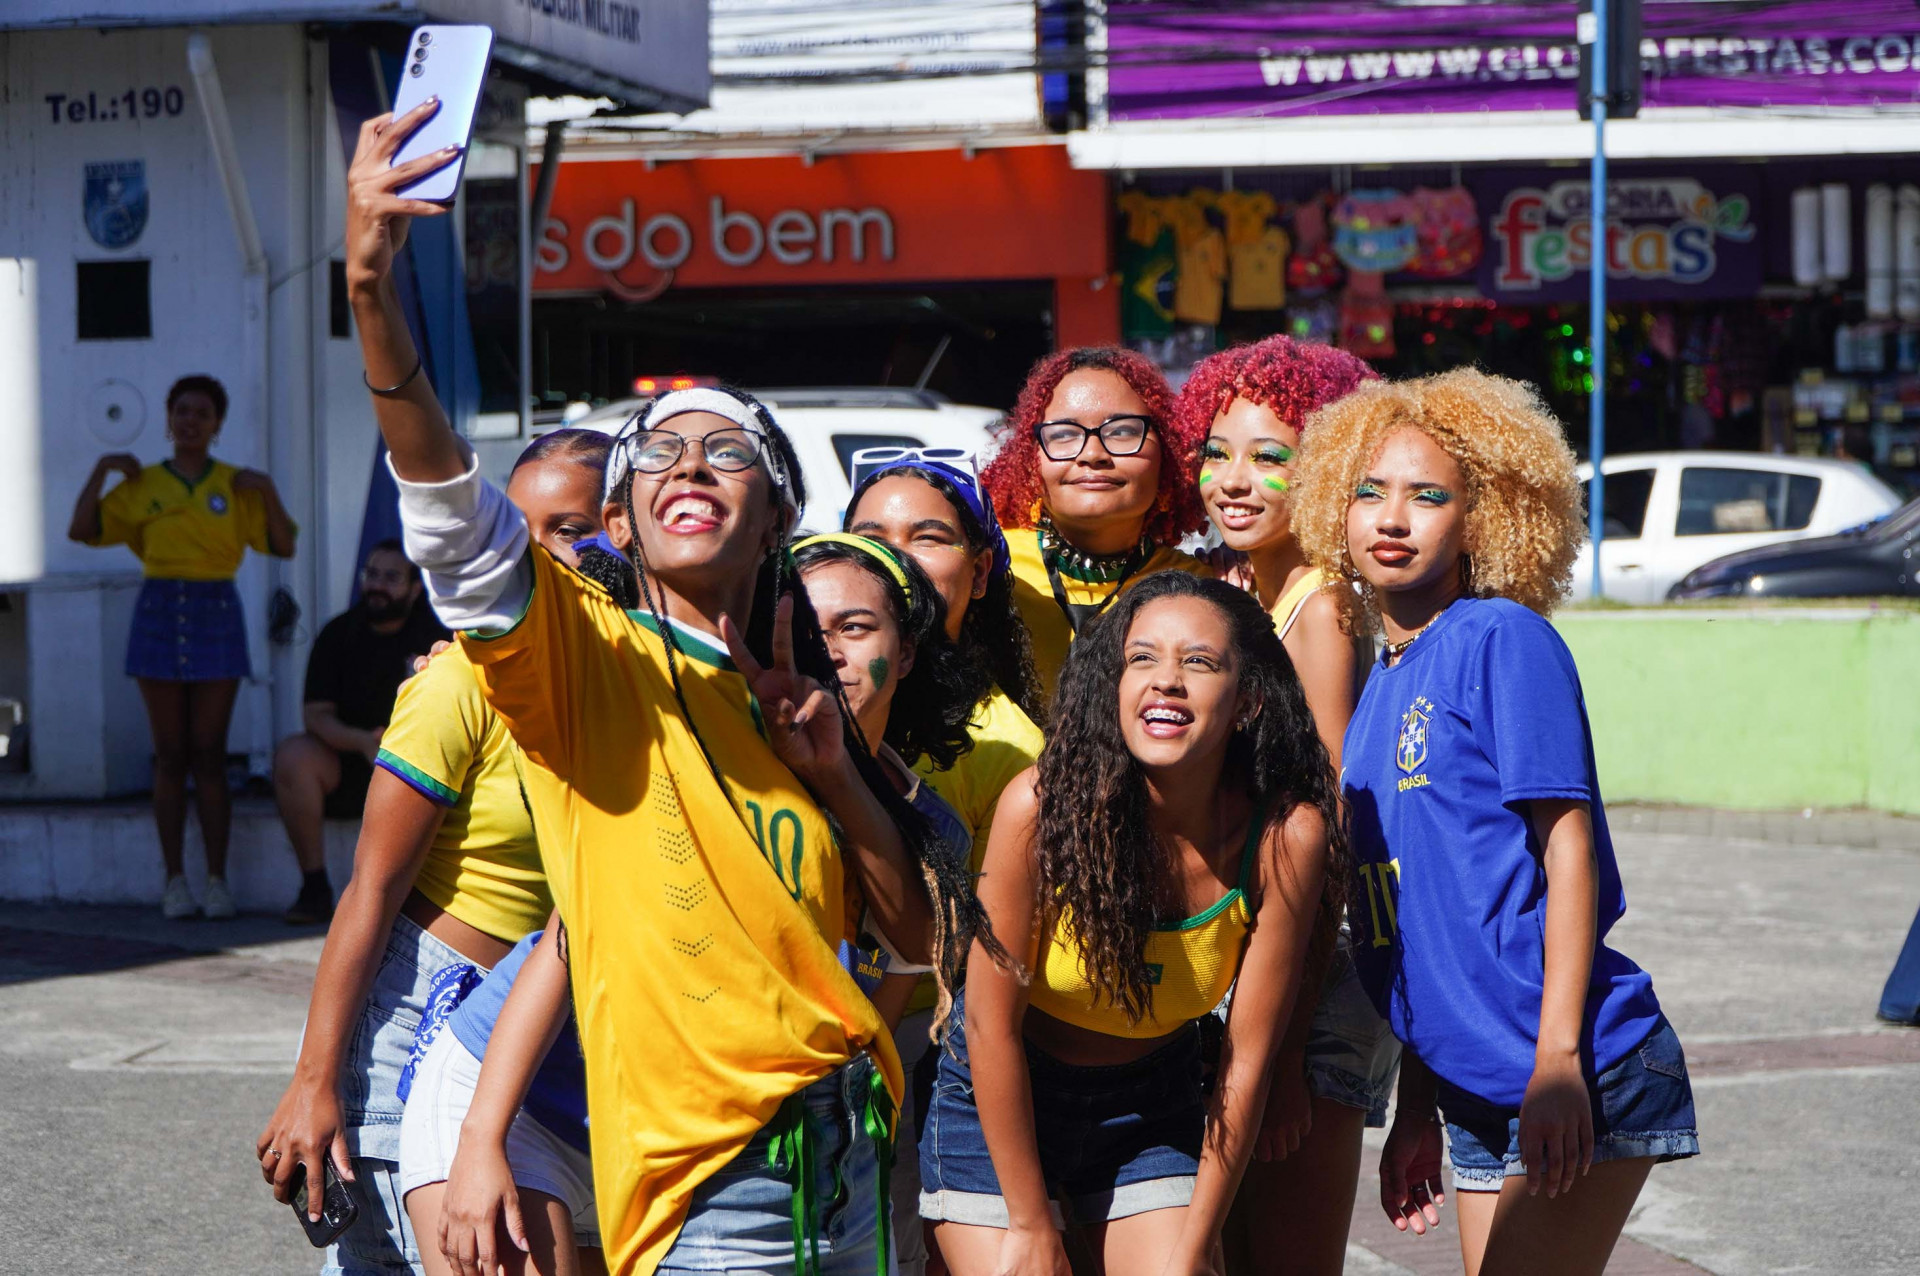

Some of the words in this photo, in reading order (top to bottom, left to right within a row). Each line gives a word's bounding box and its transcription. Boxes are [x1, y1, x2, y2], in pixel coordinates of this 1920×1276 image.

[586, 0, 641, 43] MILITAR
[45, 85, 184, 124] Tel.:190
[583, 197, 692, 271] do
[711, 196, 894, 266] bem
[1495, 195, 1709, 282] festas
[1403, 732, 1418, 744] CBF
[1398, 773, 1431, 793] BRASIL
